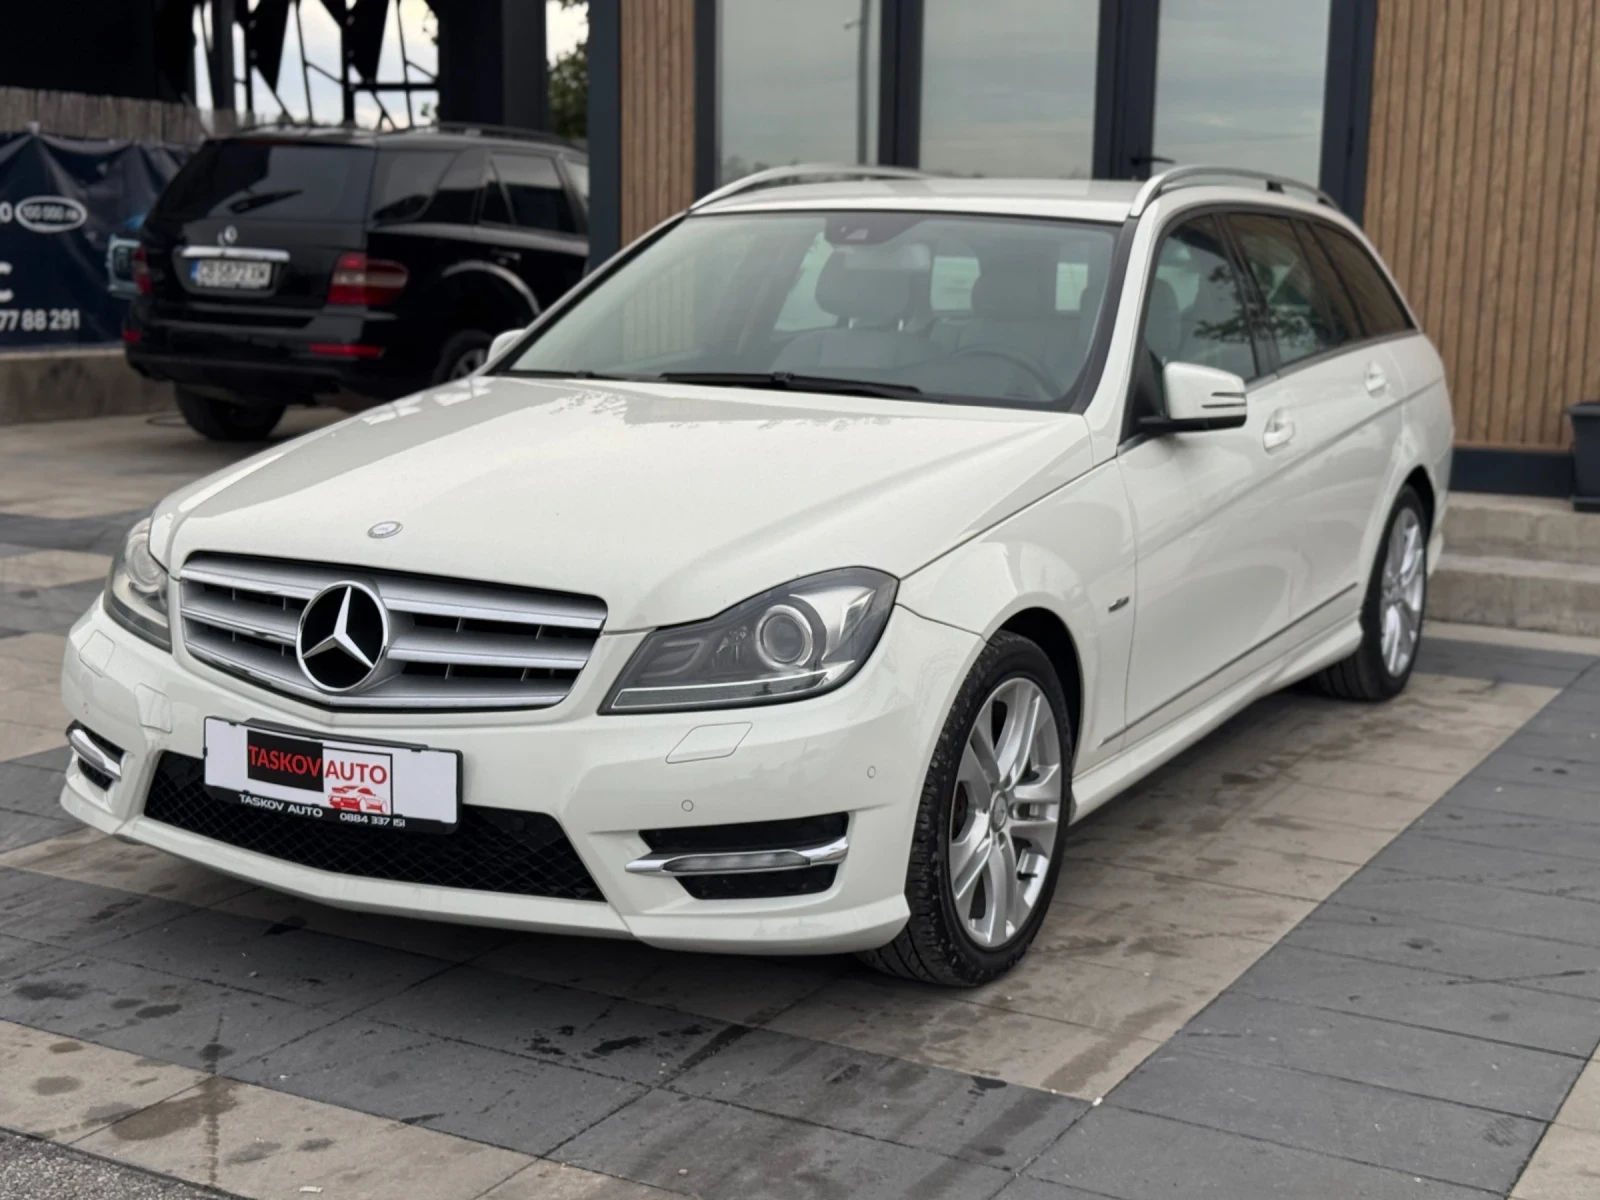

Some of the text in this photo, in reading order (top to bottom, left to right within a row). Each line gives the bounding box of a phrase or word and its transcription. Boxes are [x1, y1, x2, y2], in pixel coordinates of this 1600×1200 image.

[22, 308, 47, 331] 88
[49, 308, 80, 331] 291
[248, 745, 387, 784] TASKOV AUTO
[239, 794, 284, 811] TASKOV
[287, 804, 323, 818] AUTO
[340, 813, 368, 824] 0884
[371, 816, 390, 826] 337
